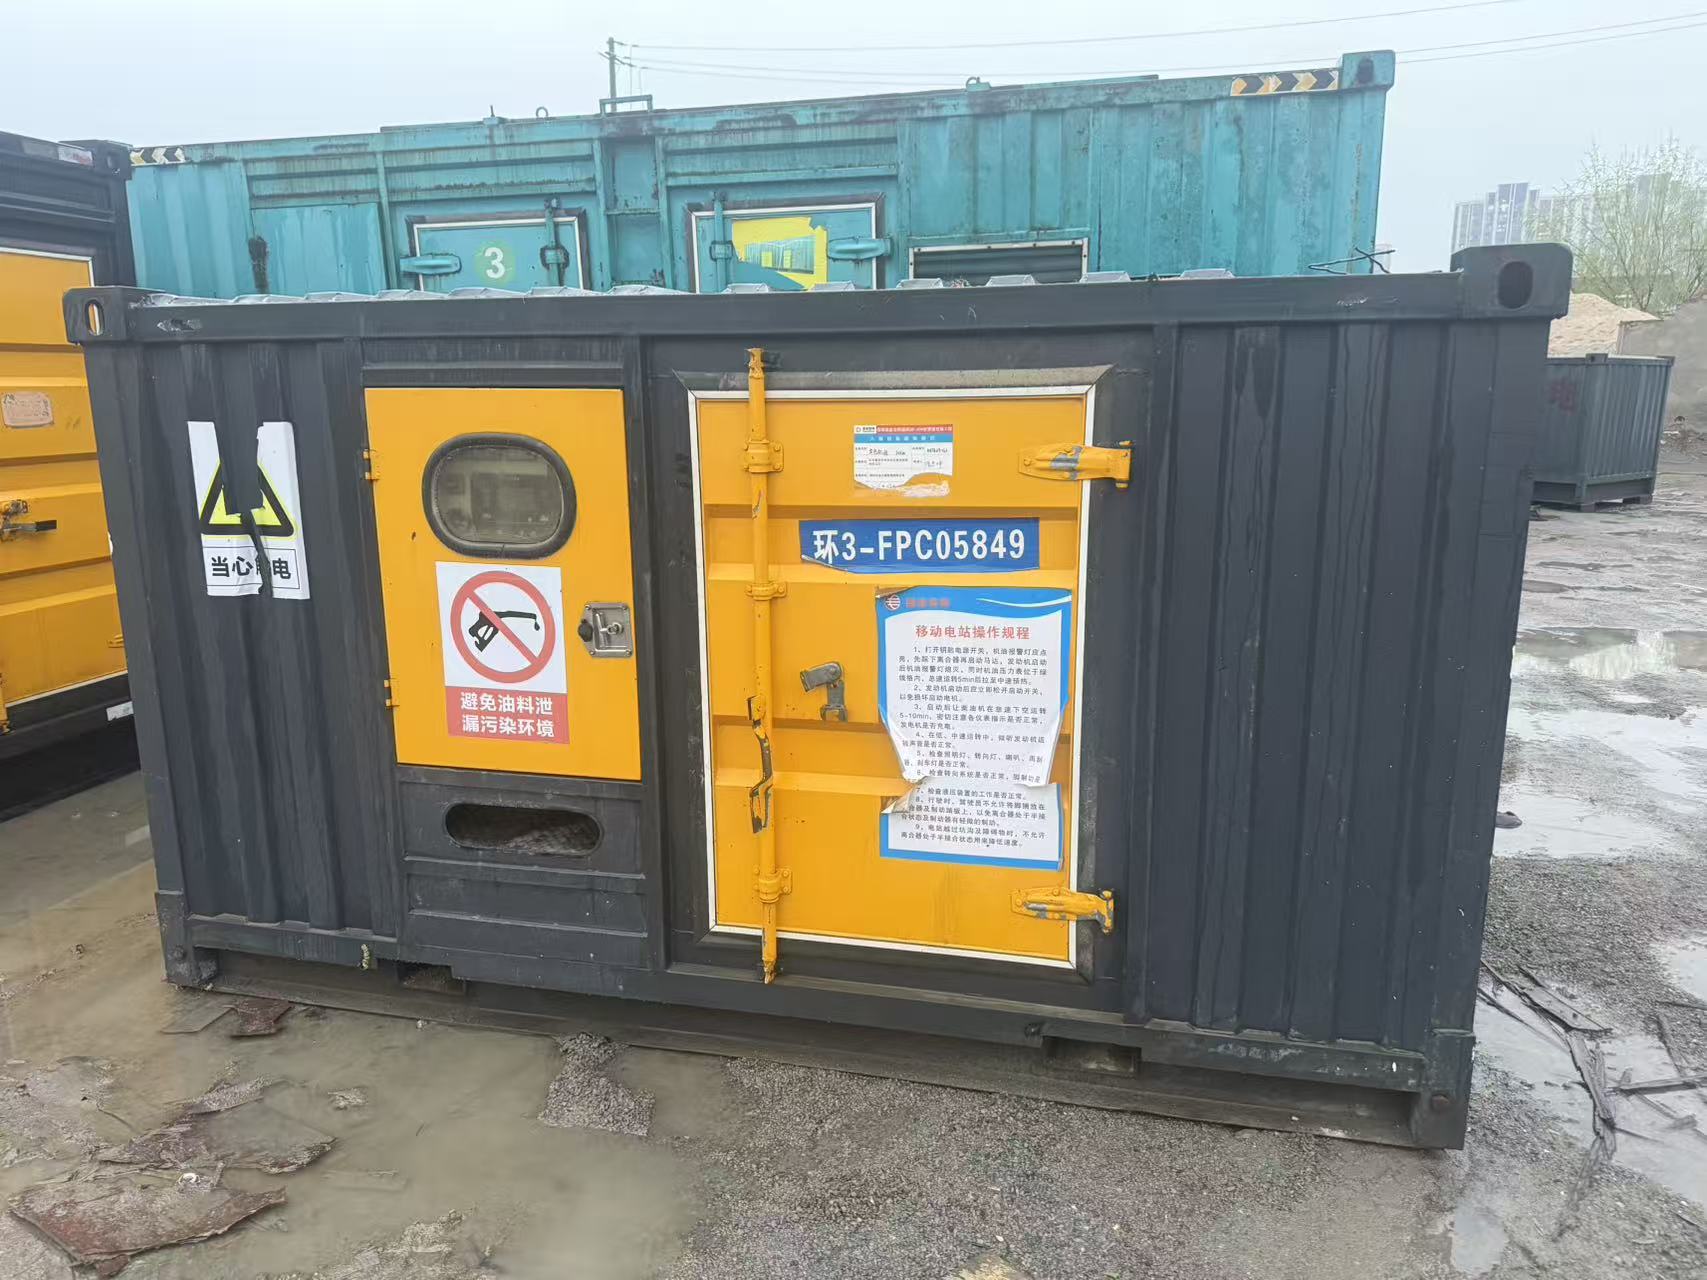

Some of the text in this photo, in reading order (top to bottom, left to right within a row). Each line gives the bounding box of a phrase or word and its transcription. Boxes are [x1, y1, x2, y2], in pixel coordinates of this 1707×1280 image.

[484, 246, 505, 280] 3
[812, 528, 1025, 564] 环3-FPC05849
[211, 555, 292, 580] 当心电
[915, 625, 1031, 640] 移动电站操作规程
[460, 691, 554, 716] 避免油料泄
[462, 714, 555, 738] 漏污染环境
